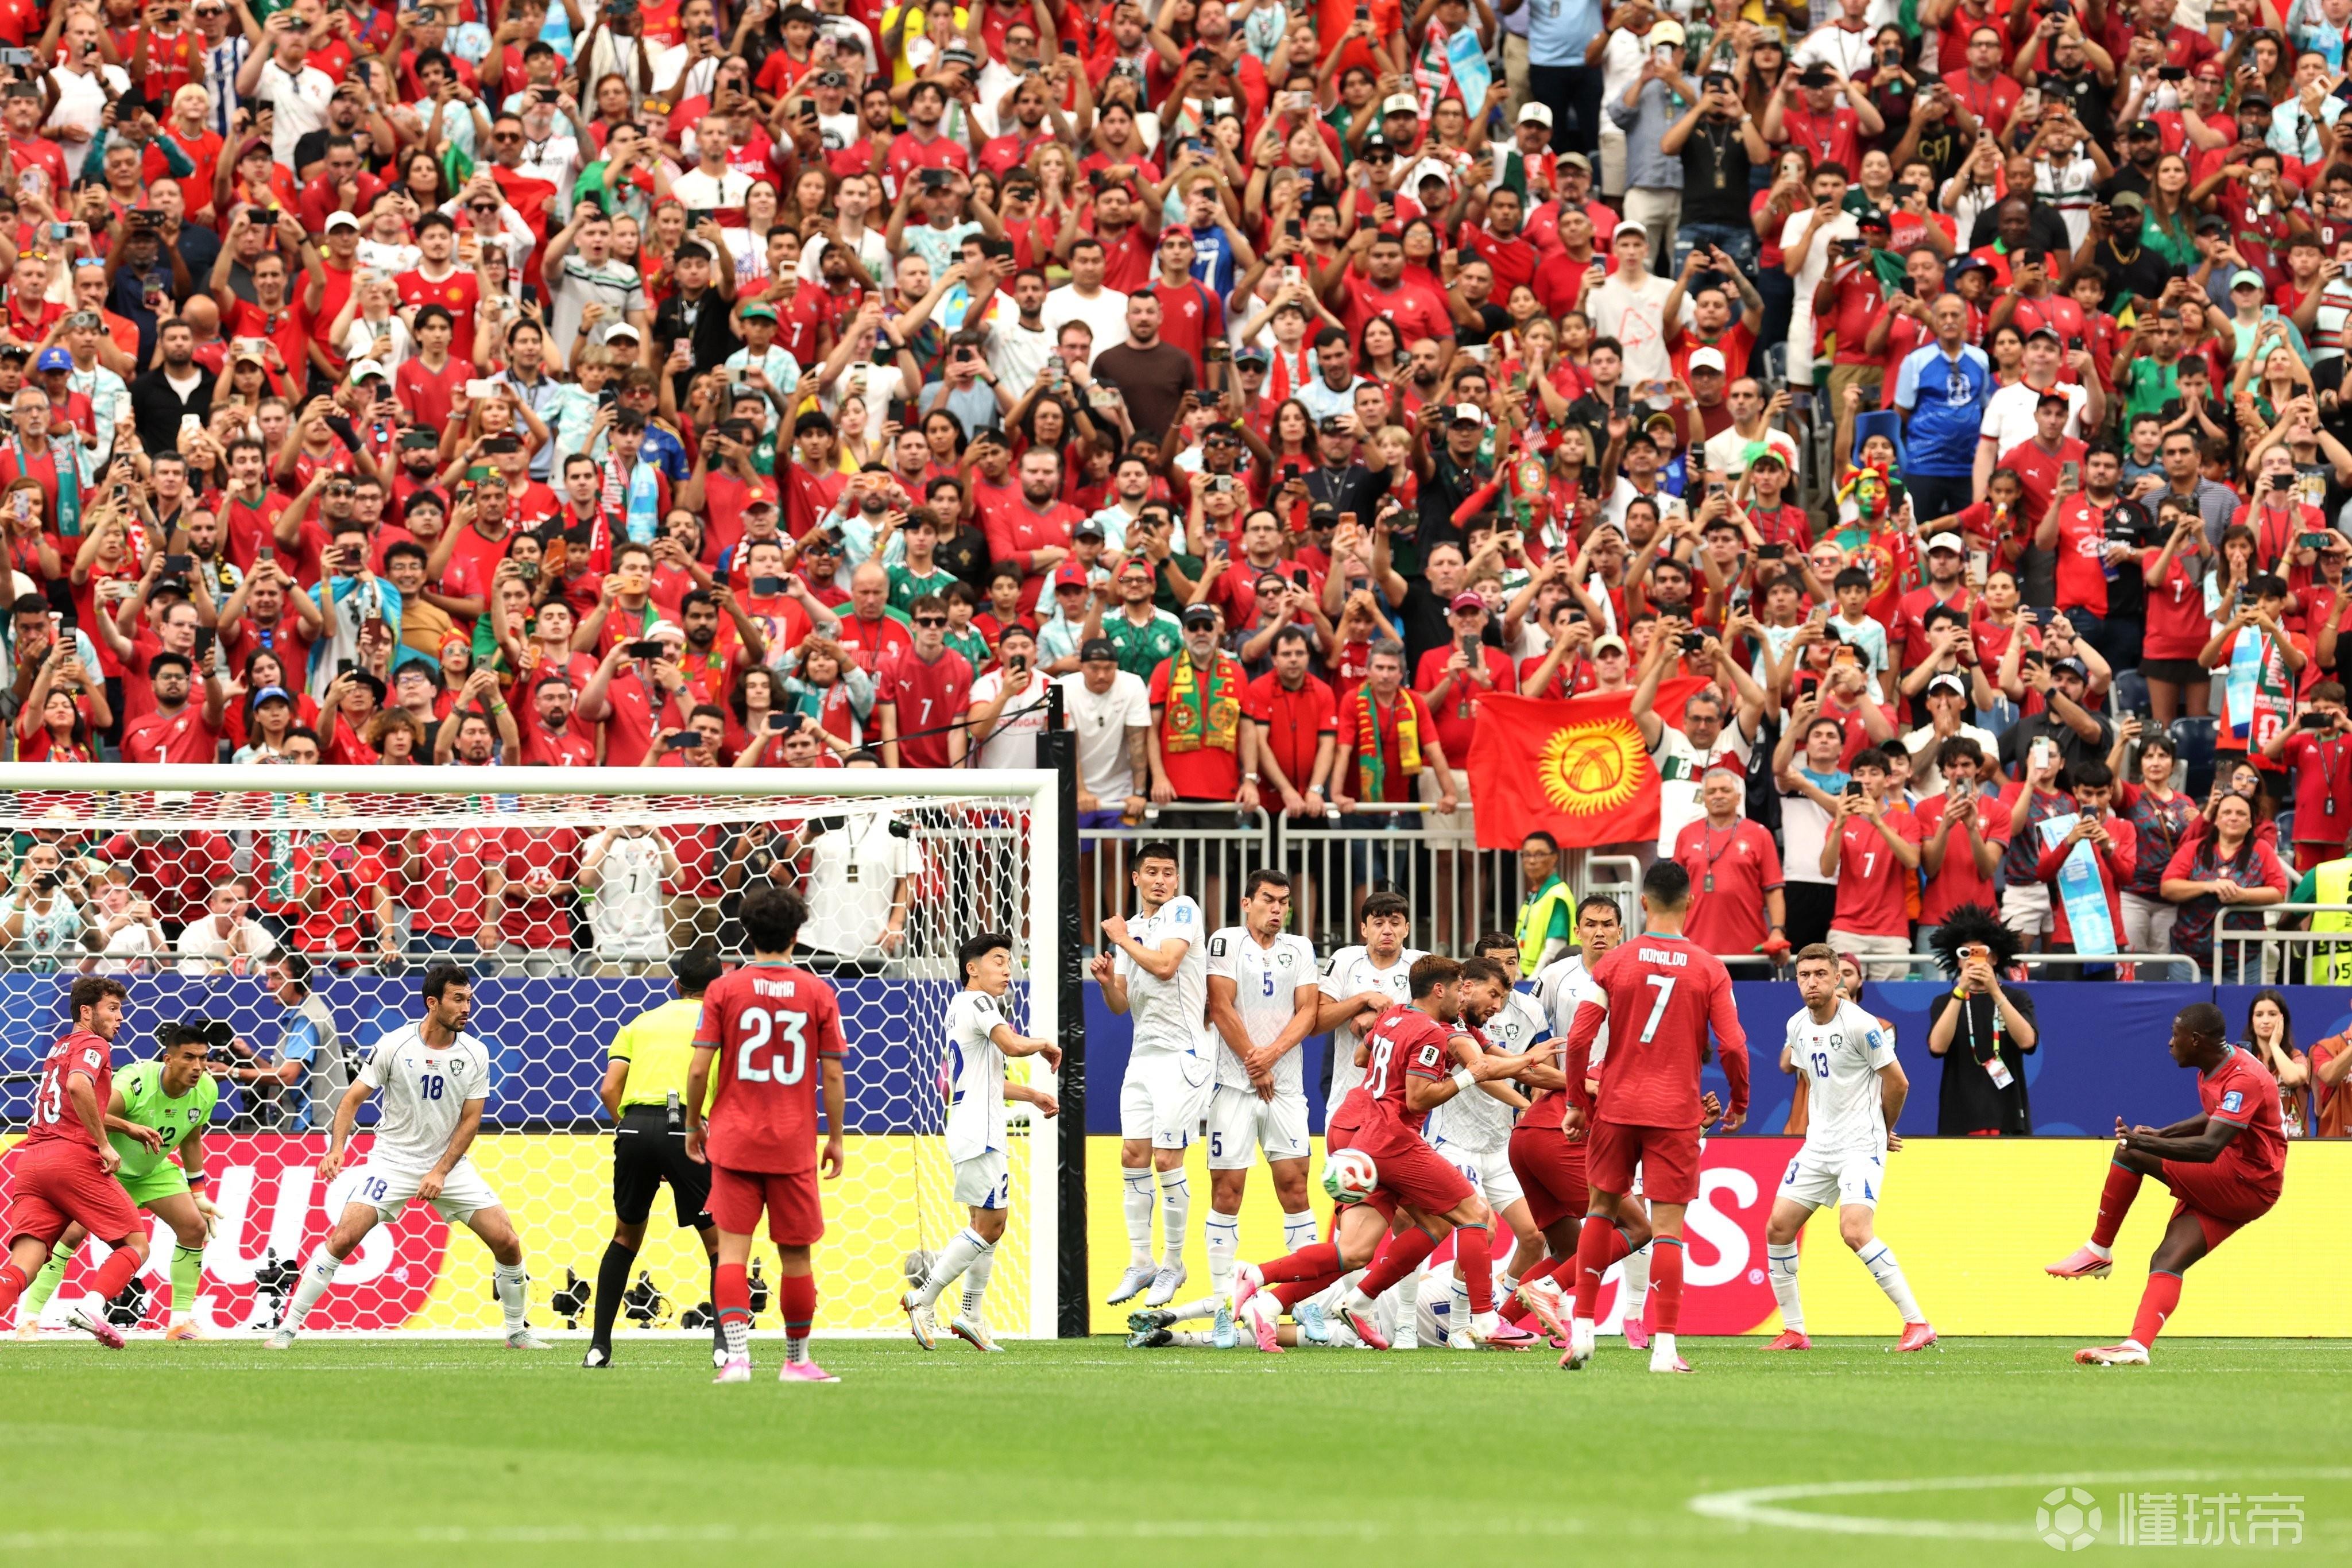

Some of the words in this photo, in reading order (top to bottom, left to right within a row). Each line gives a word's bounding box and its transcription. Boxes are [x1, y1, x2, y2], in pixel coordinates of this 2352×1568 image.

[1864, 293, 1875, 313] 7
[790, 322, 803, 347] 7
[253, 531, 264, 551] 7
[2171, 579, 2183, 603] 7
[920, 698, 933, 725] 7
[1675, 757, 1693, 779] 13
[1863, 852, 1875, 878] 7
[629, 874, 637, 893] 7
[1638, 947, 1688, 967] RONALDO
[753, 978, 795, 997] VITINHA
[1263, 971, 1274, 997] 5
[1639, 974, 1677, 1044] 7
[1506, 1025, 1518, 1033] UFA
[737, 1006, 808, 1085] 23
[451, 1060, 464, 1069] UFA
[1812, 1052, 1829, 1078] 13
[420, 1074, 444, 1101] 18
[1212, 1131, 1222, 1158] 5
[1784, 1160, 1800, 1184] 3
[362, 1175, 388, 1202] 18
